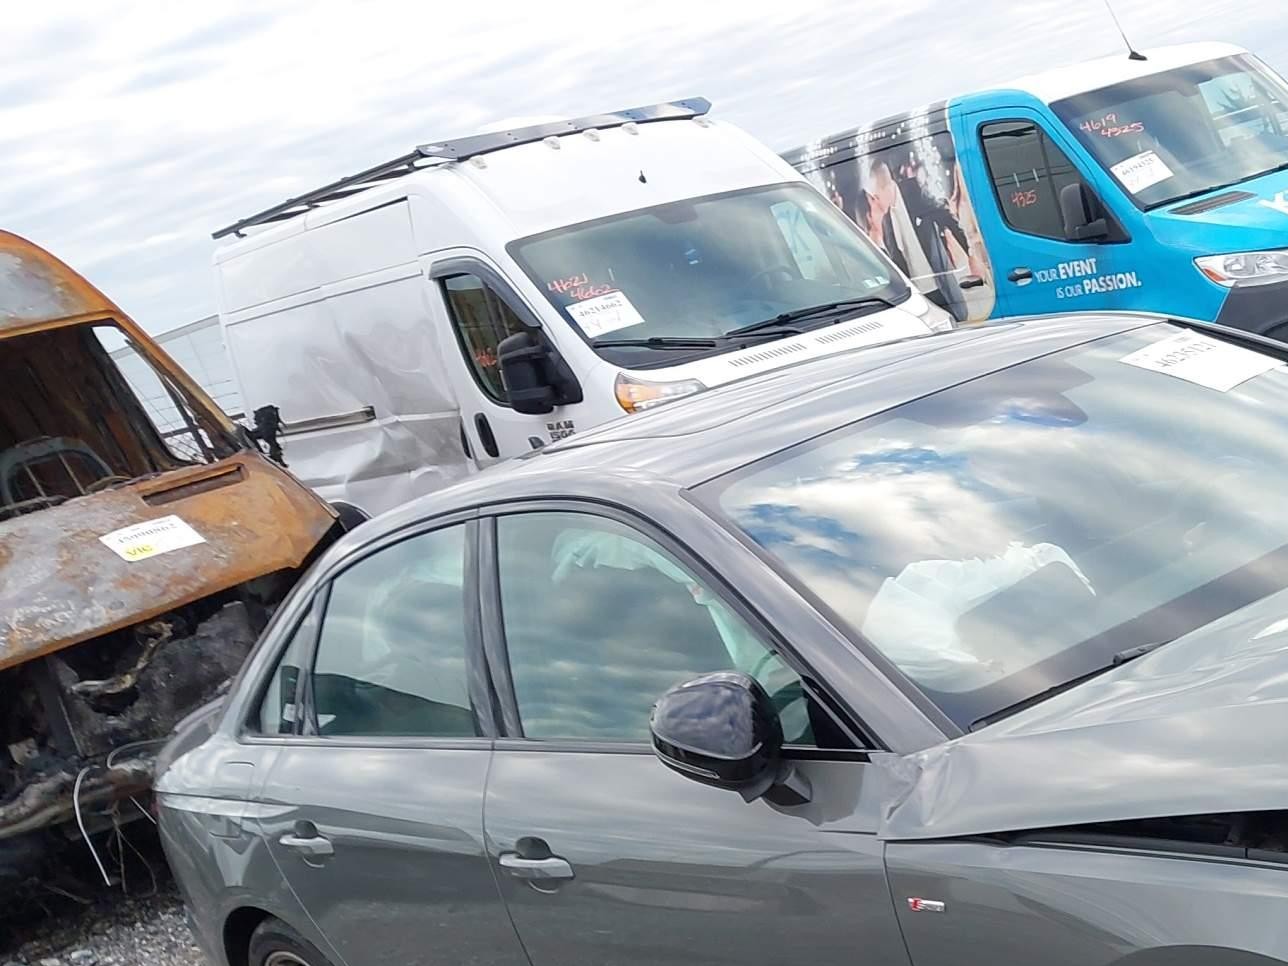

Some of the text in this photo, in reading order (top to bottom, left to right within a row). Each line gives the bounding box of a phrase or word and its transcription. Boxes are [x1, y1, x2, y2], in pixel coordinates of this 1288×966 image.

[1080, 113, 1117, 132] 4619
[1034, 258, 1098, 283] YOUR EVENT
[1056, 271, 1142, 299] IS OUR PASSION.
[546, 420, 575, 431] RAM
